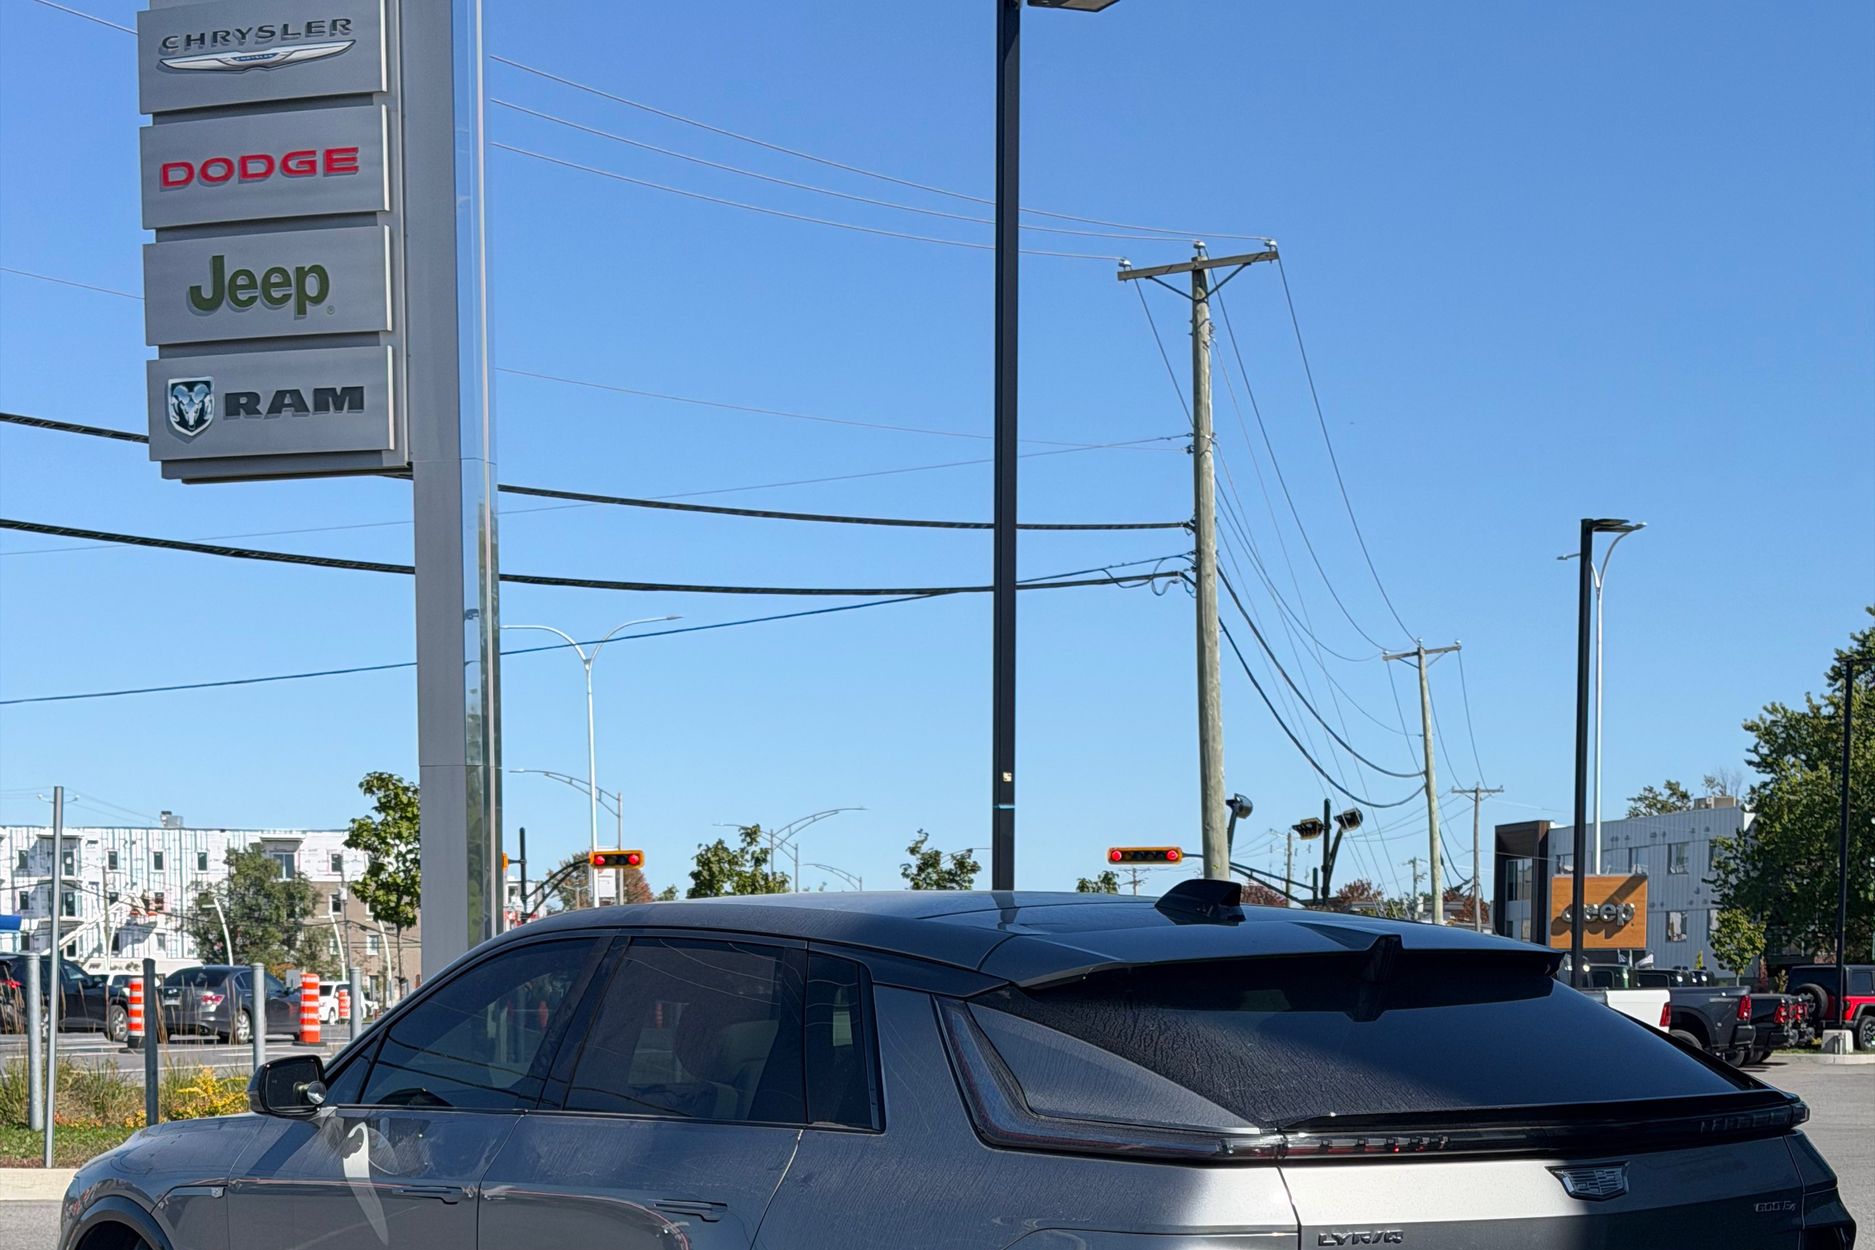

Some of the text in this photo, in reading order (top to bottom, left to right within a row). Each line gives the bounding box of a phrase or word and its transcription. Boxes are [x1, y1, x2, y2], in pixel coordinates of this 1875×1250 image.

[161, 18, 353, 50] CHRYSLER
[161, 147, 359, 187] DODGE
[188, 255, 330, 315] Jeep
[224, 386, 365, 417] RAM
